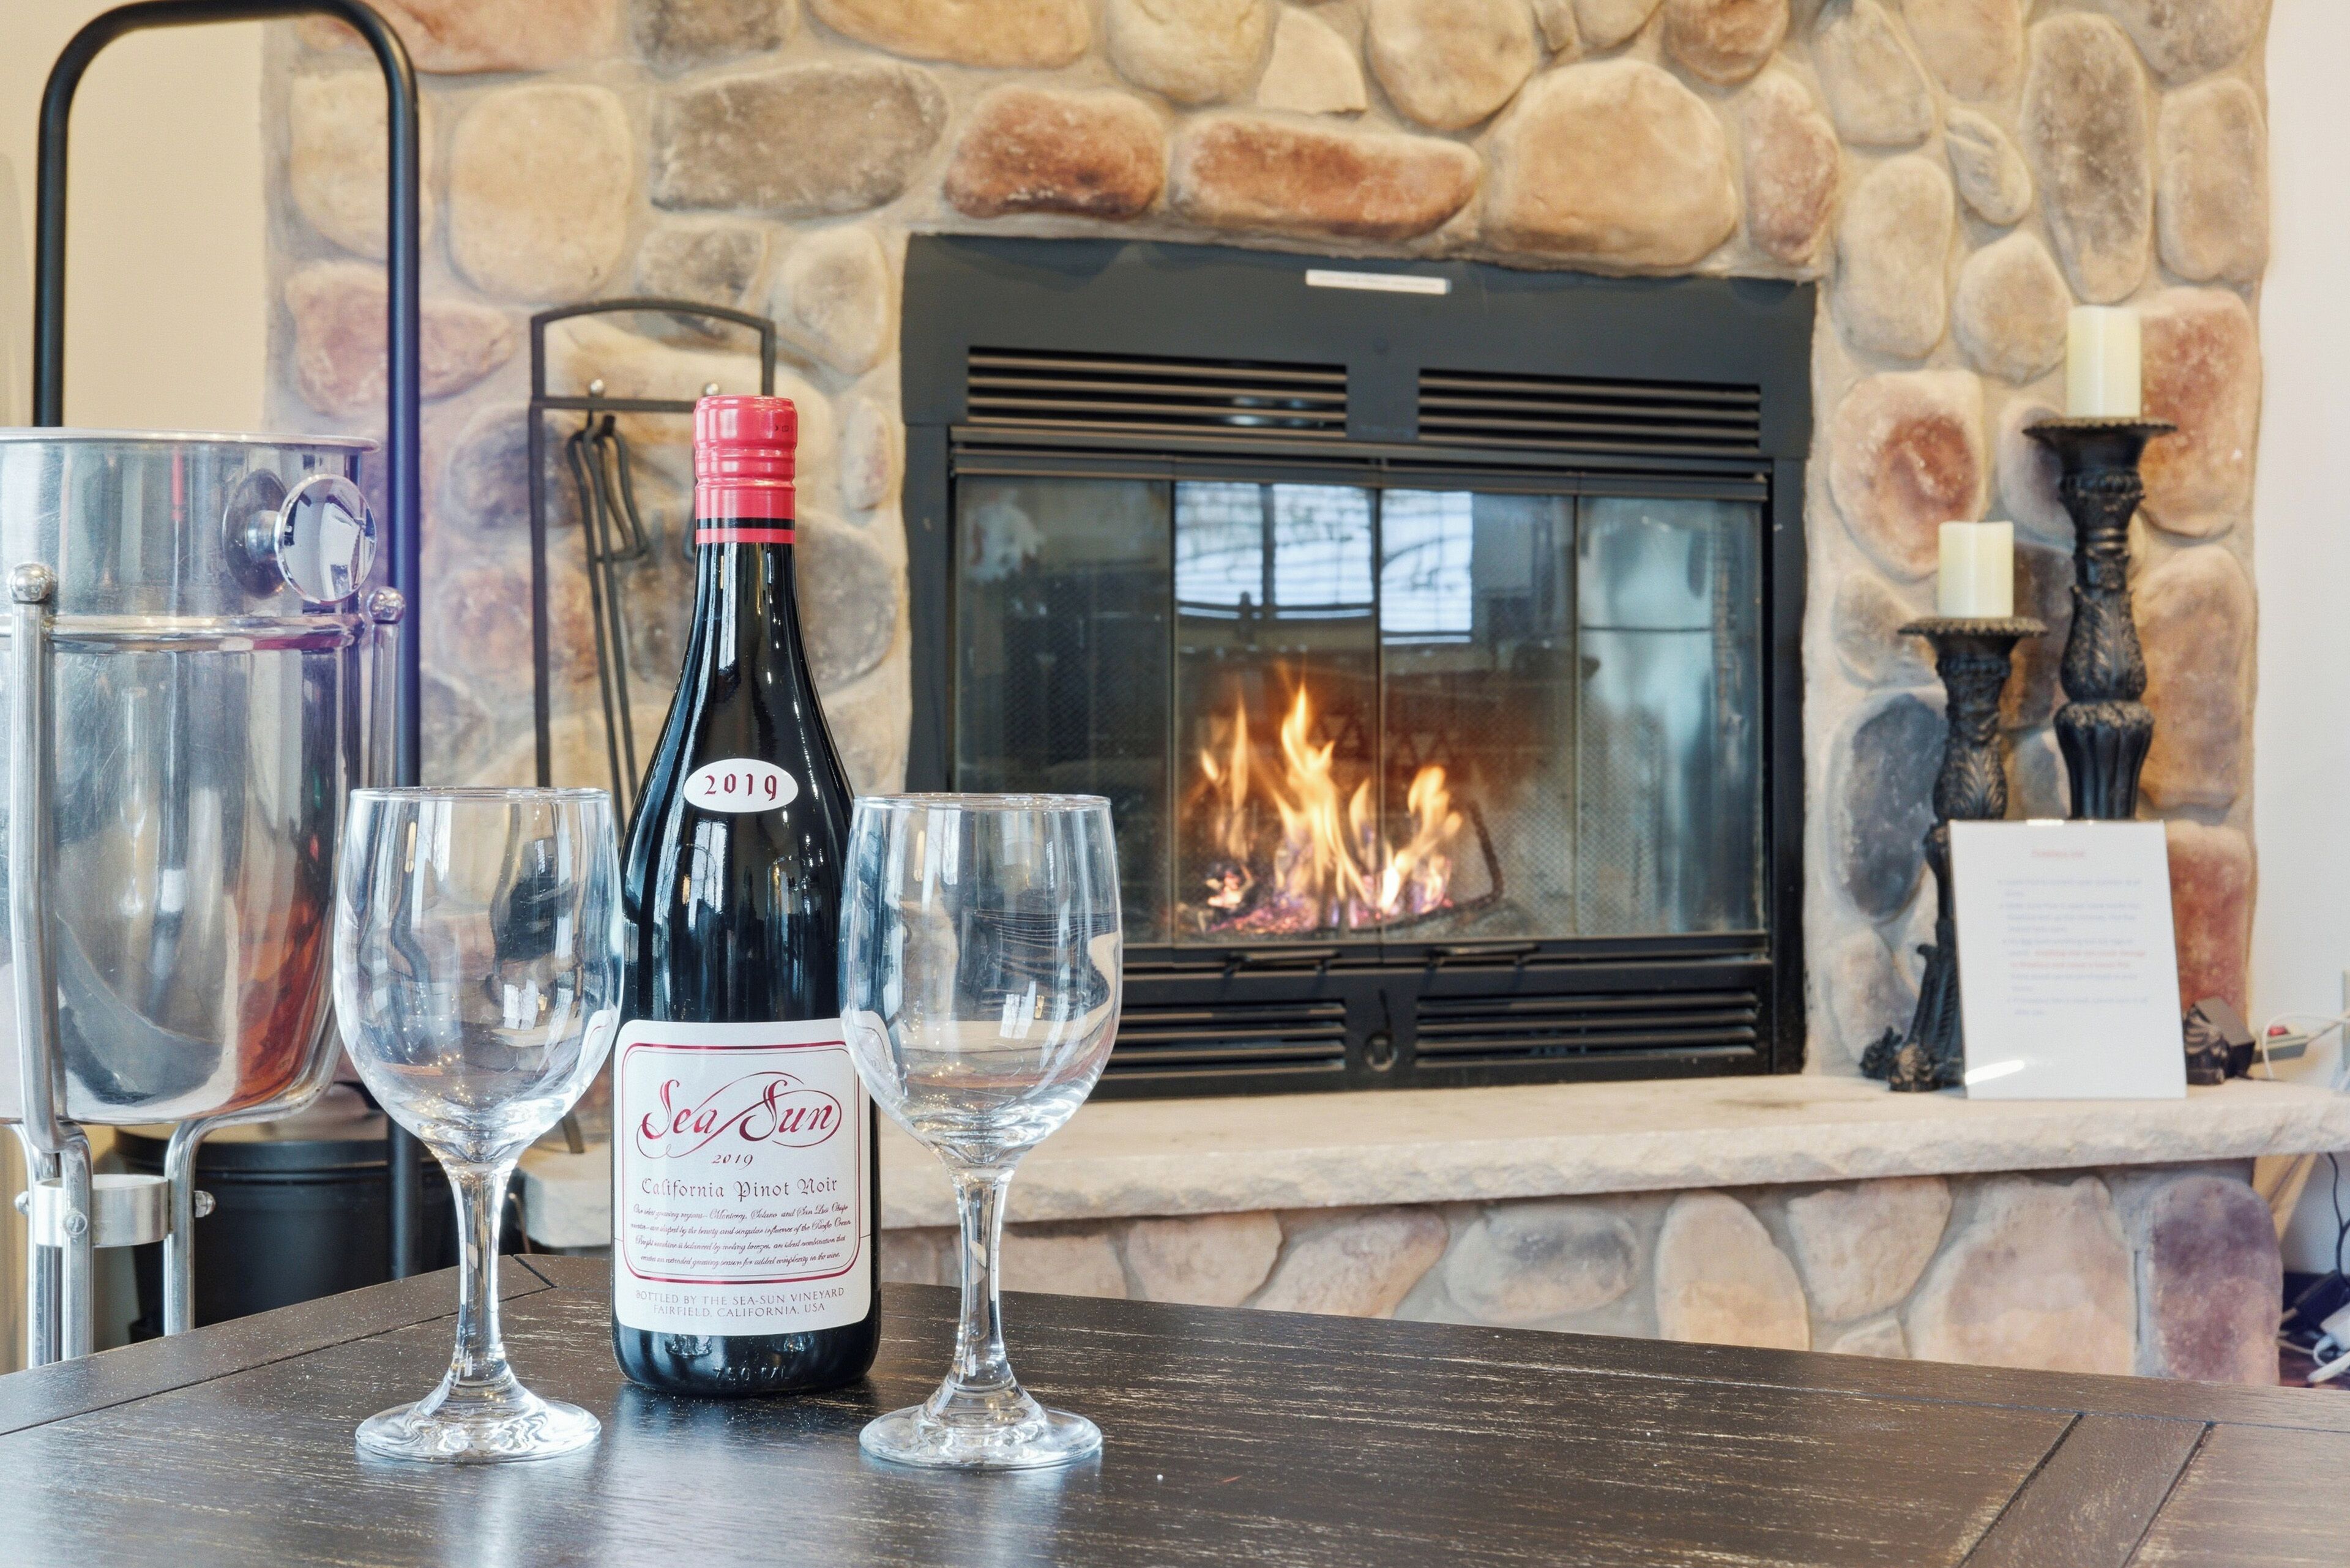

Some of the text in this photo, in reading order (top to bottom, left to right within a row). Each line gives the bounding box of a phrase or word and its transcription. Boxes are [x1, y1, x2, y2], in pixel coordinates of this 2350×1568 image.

[704, 773, 777, 802] 2019
[640, 1078, 832, 1142] Sea Sun
[712, 1154, 753, 1170] 2019
[641, 1176, 837, 1202] California Pinot Noir
[636, 1286, 845, 1305] BOTTLED BY THE SEA-SUN VINEYARD
[804, 1302, 825, 1313] USA
